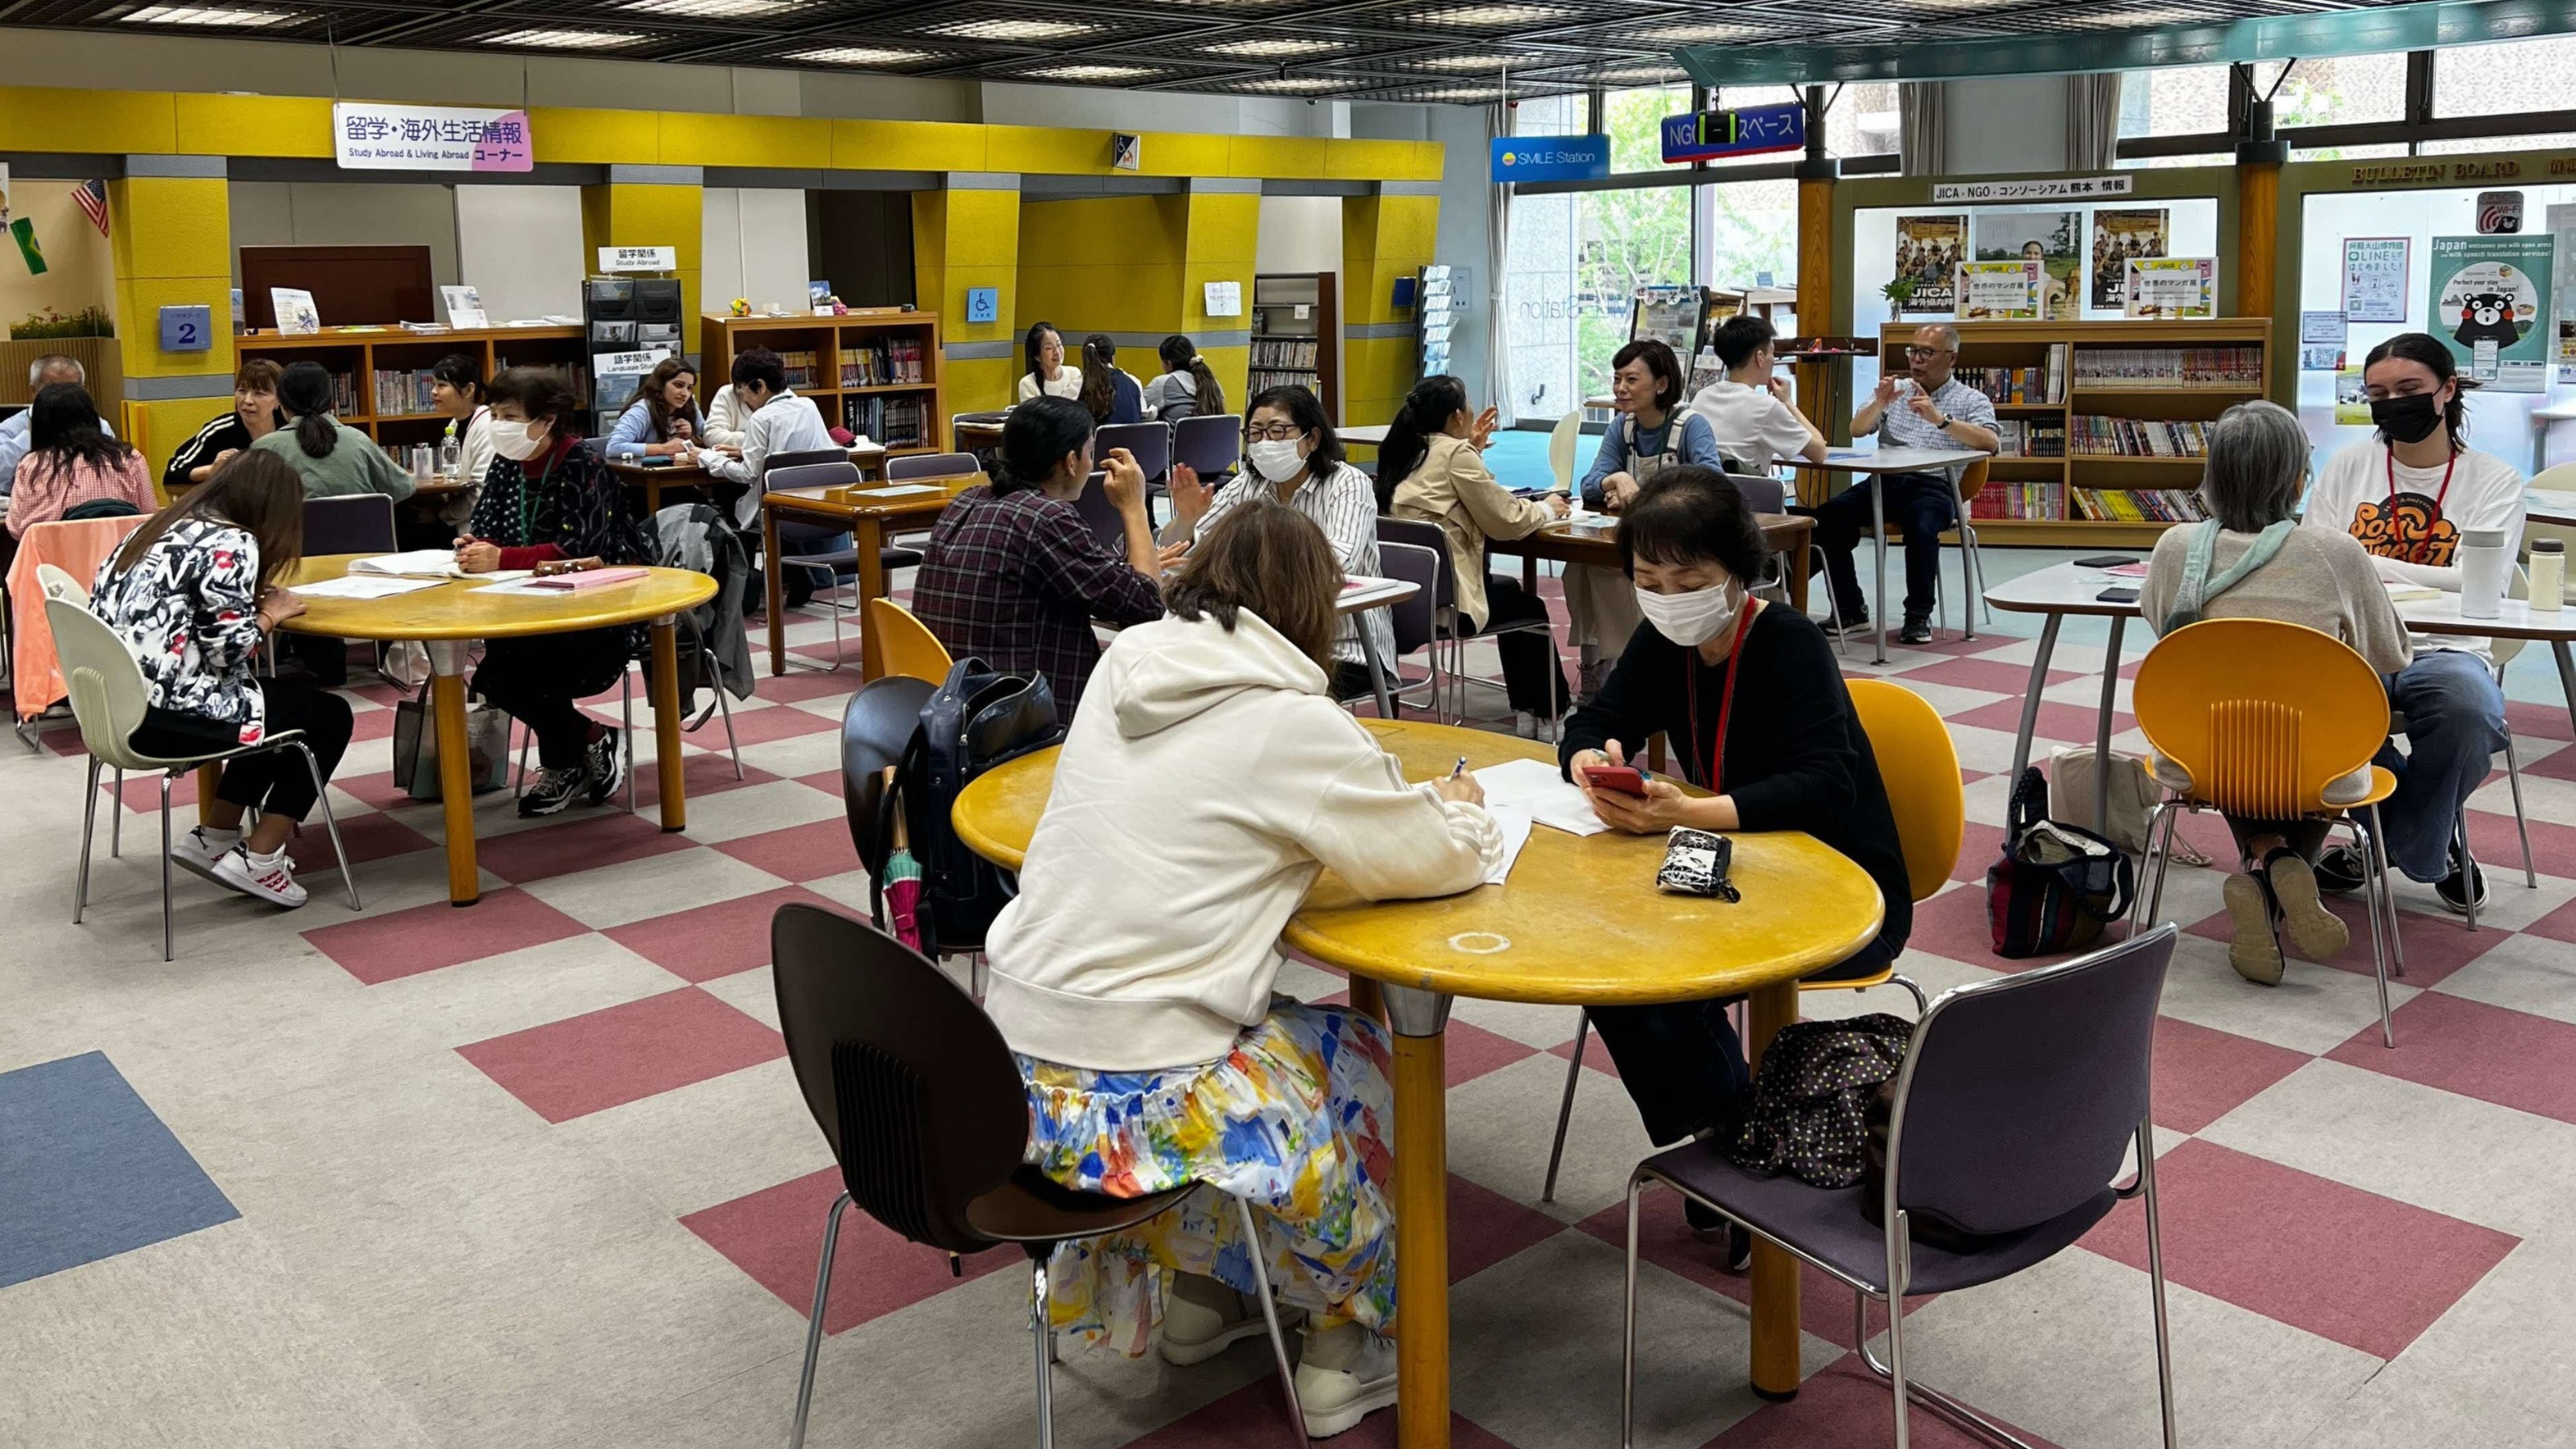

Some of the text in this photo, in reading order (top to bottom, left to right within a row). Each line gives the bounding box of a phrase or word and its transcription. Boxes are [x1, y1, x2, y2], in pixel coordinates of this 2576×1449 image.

[346, 116, 522, 144] 留学・海外生活情報
[349, 148, 469, 160] Study Abroad & Living Abroad
[476, 150, 523, 162] コーナー
[1518, 151, 1595, 165] SMILE Station
[2352, 161, 2519, 184] BULLETIN BOARD
[2433, 239, 2467, 253] Japan
[2361, 251, 2389, 261] LINE
[1911, 287, 1953, 298] JICA
[178, 323, 196, 344] 2
